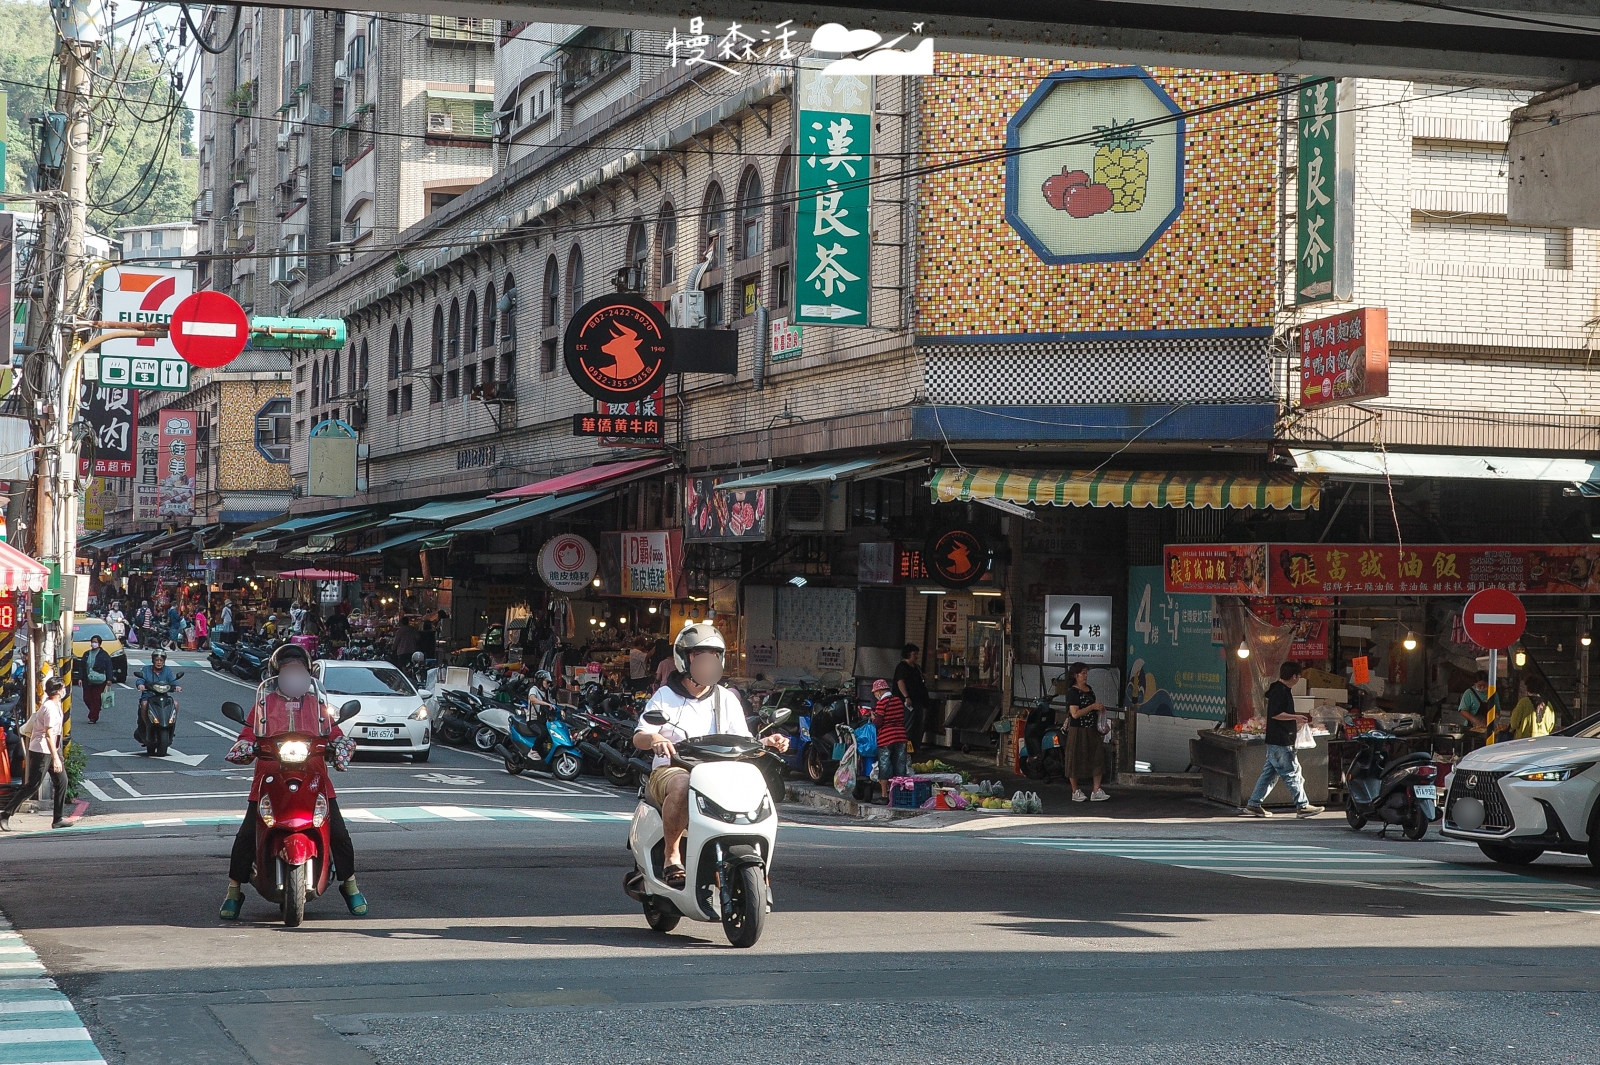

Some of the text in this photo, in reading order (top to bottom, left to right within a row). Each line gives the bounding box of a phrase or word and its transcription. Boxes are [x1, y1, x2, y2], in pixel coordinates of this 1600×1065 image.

[1303, 82, 1333, 275] 漢良茶
[804, 117, 864, 297] 漢良茶
[135, 361, 155, 370] ATM
[1311, 349, 1351, 377] 鴨肉飯
[1290, 549, 1460, 588] 張富誠油飯
[1322, 582, 1394, 592] 招牌手工麻油飯
[1400, 582, 1429, 592] 素油飯
[1060, 602, 1083, 637] 4
[1089, 624, 1101, 637] 梯
[1135, 583, 1152, 645] 4
